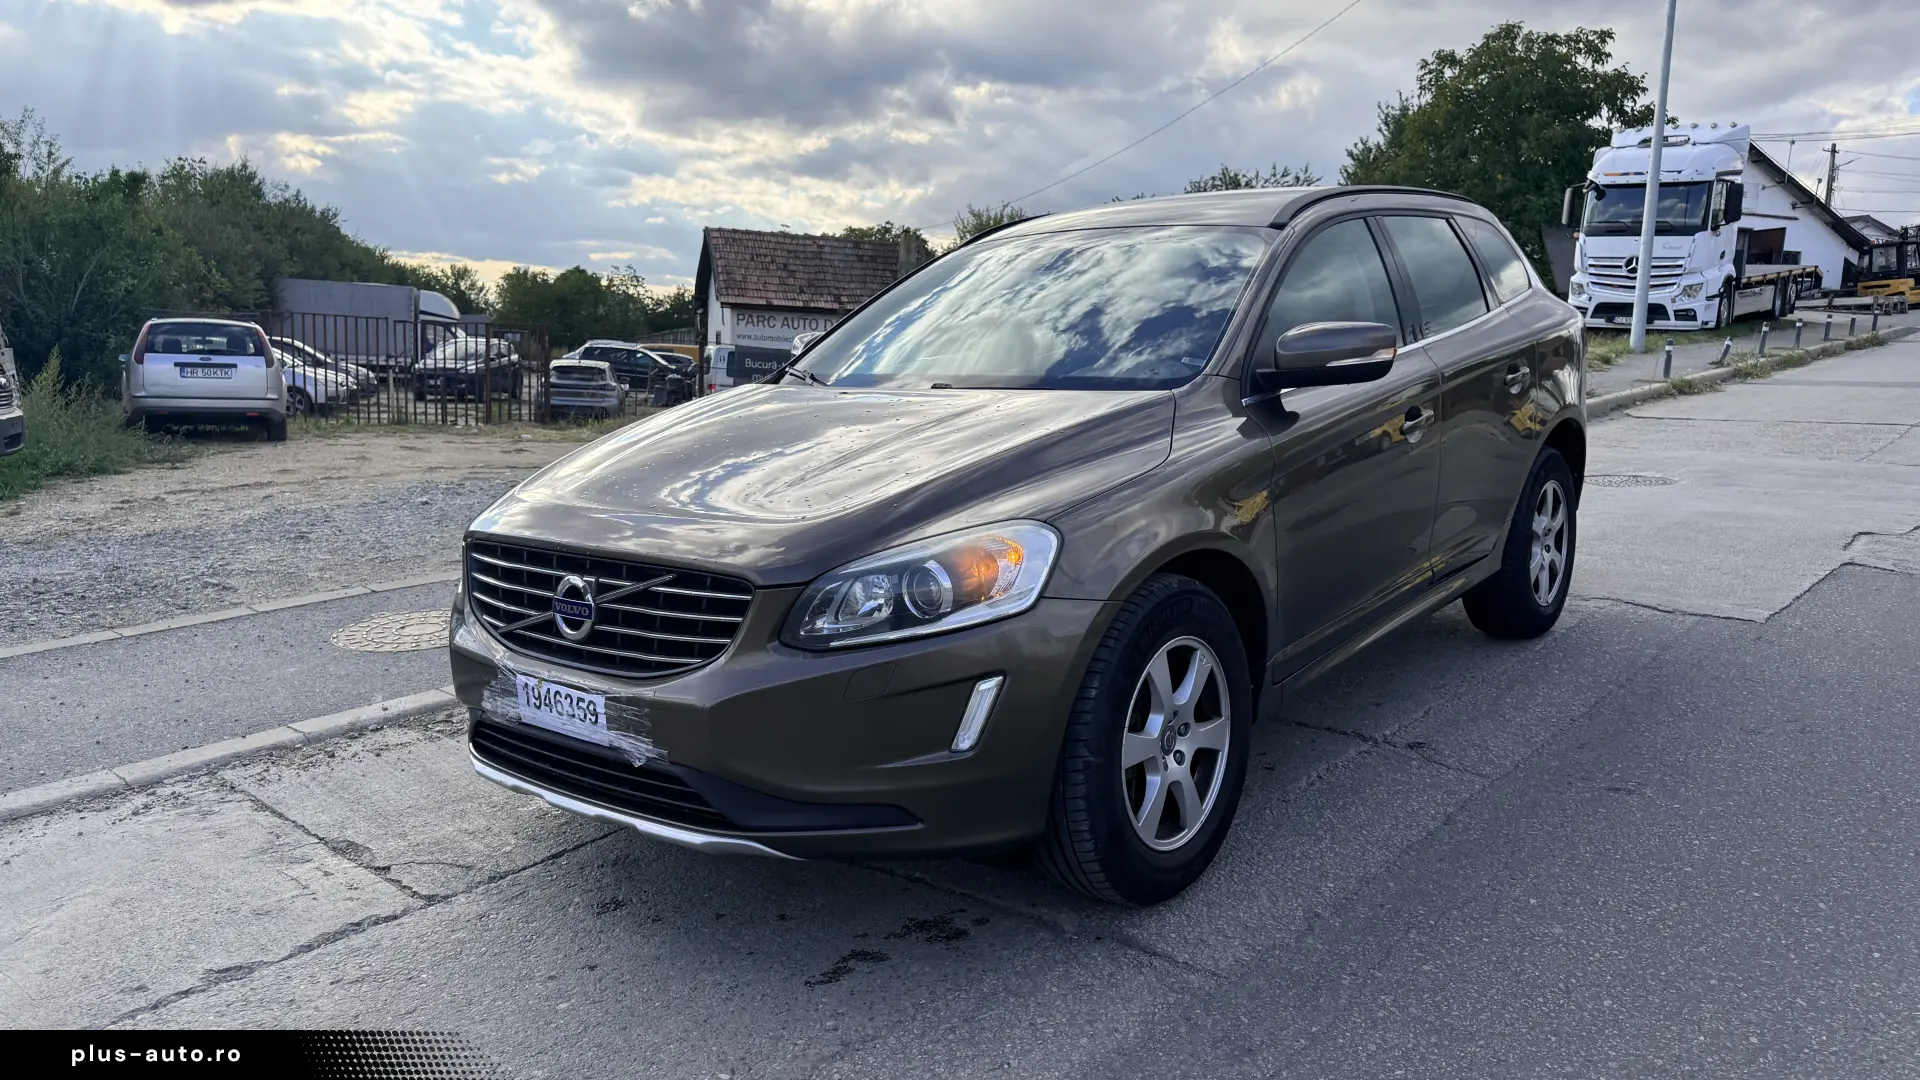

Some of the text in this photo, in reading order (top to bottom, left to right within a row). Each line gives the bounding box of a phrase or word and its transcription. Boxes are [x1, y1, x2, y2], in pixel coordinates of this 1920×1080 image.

[736, 312, 776, 328] PARC
[780, 316, 819, 331] AUTO
[186, 368, 199, 376] HR
[554, 601, 590, 616] VOLVO
[521, 681, 600, 726] 1946359
